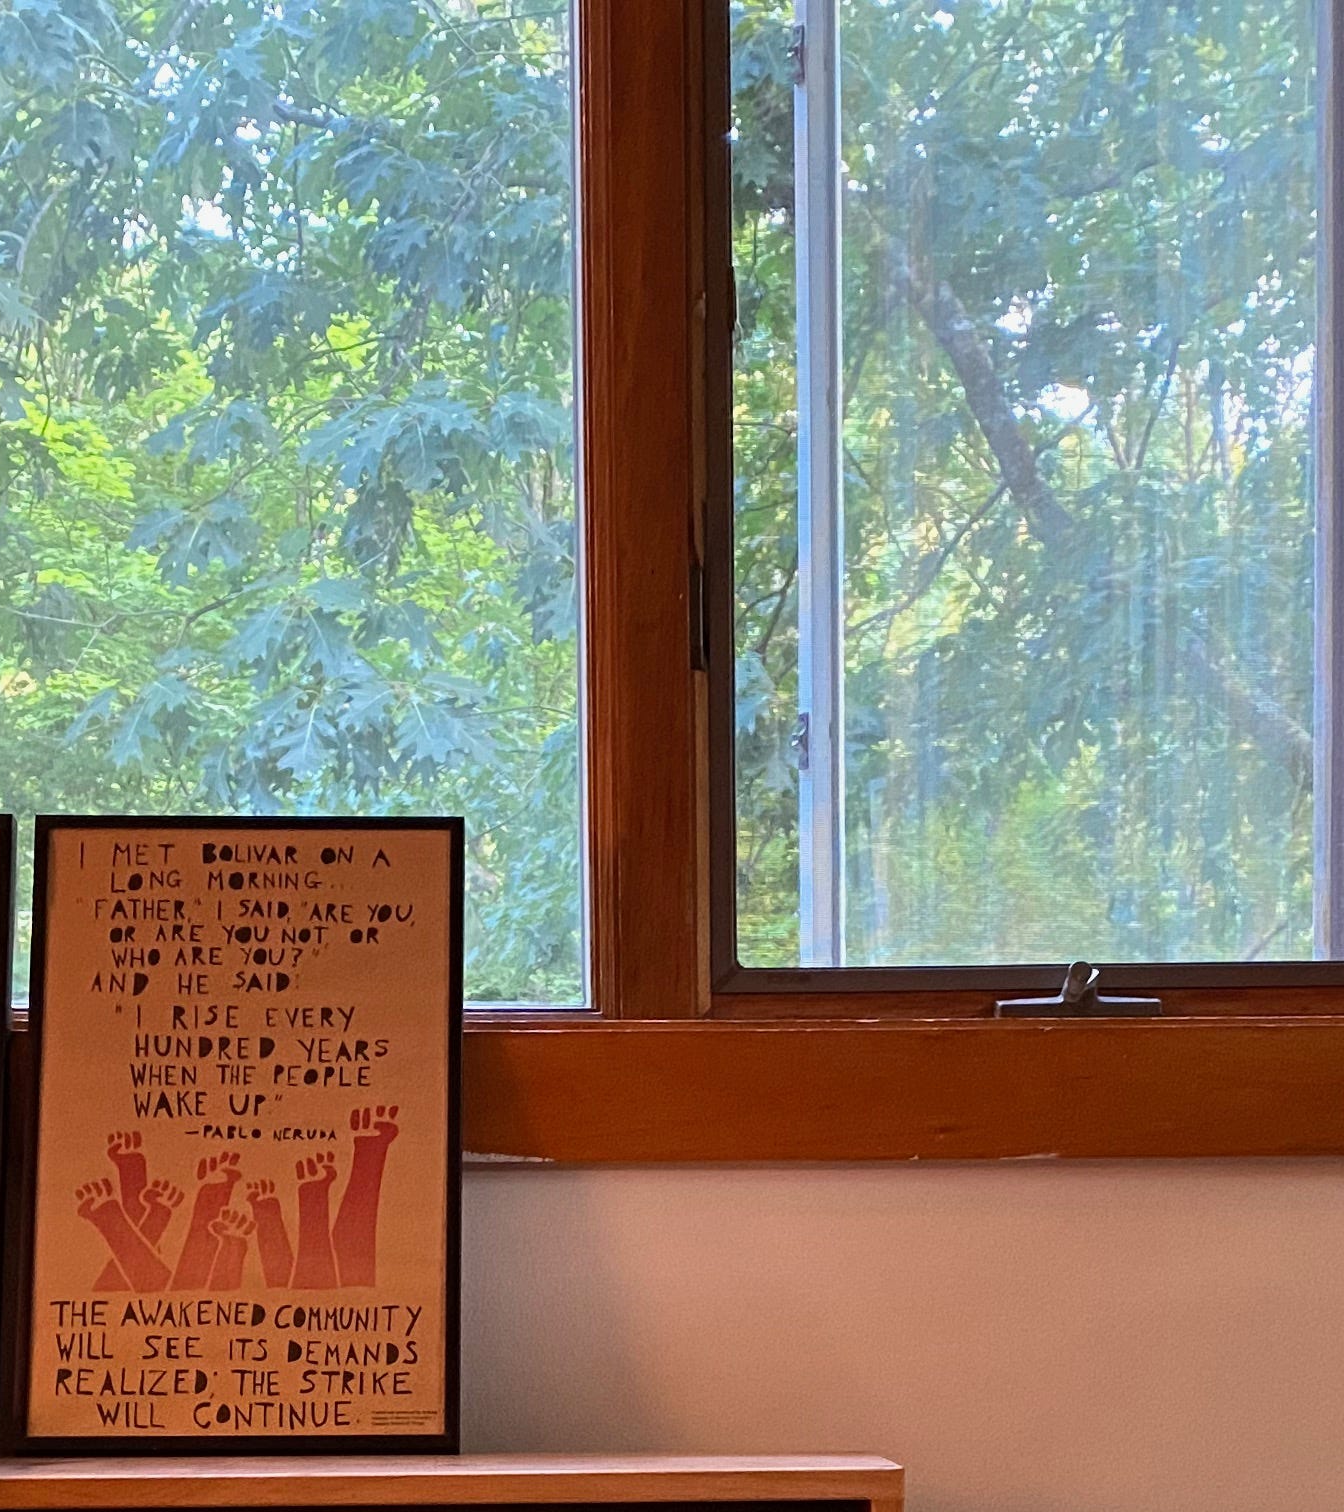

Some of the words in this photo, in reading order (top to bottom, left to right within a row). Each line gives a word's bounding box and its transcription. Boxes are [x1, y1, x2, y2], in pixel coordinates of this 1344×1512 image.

[79, 842, 85, 868] I
[112, 844, 175, 866] MET
[202, 843, 298, 865] BOLIVAR
[321, 845, 354, 865] ON
[371, 848, 391, 868] A
[135, 1036, 274, 1058] HUNDRED
[296, 1039, 389, 1061] YEARS
[130, 1064, 197, 1087] WHEN
[217, 1064, 255, 1085] THE
[274, 1065, 370, 1087] PEOPLE
[273, 1127, 336, 1141] NERUDA
[50, 1301, 107, 1326] THE
[121, 1301, 266, 1328] AWAKENED
[274, 1304, 423, 1332] COMMUNITY
[57, 1335, 114, 1360] WILL
[142, 1336, 201, 1359] SEE
[228, 1338, 268, 1361] ITS
[288, 1339, 418, 1364] DEMANDS
